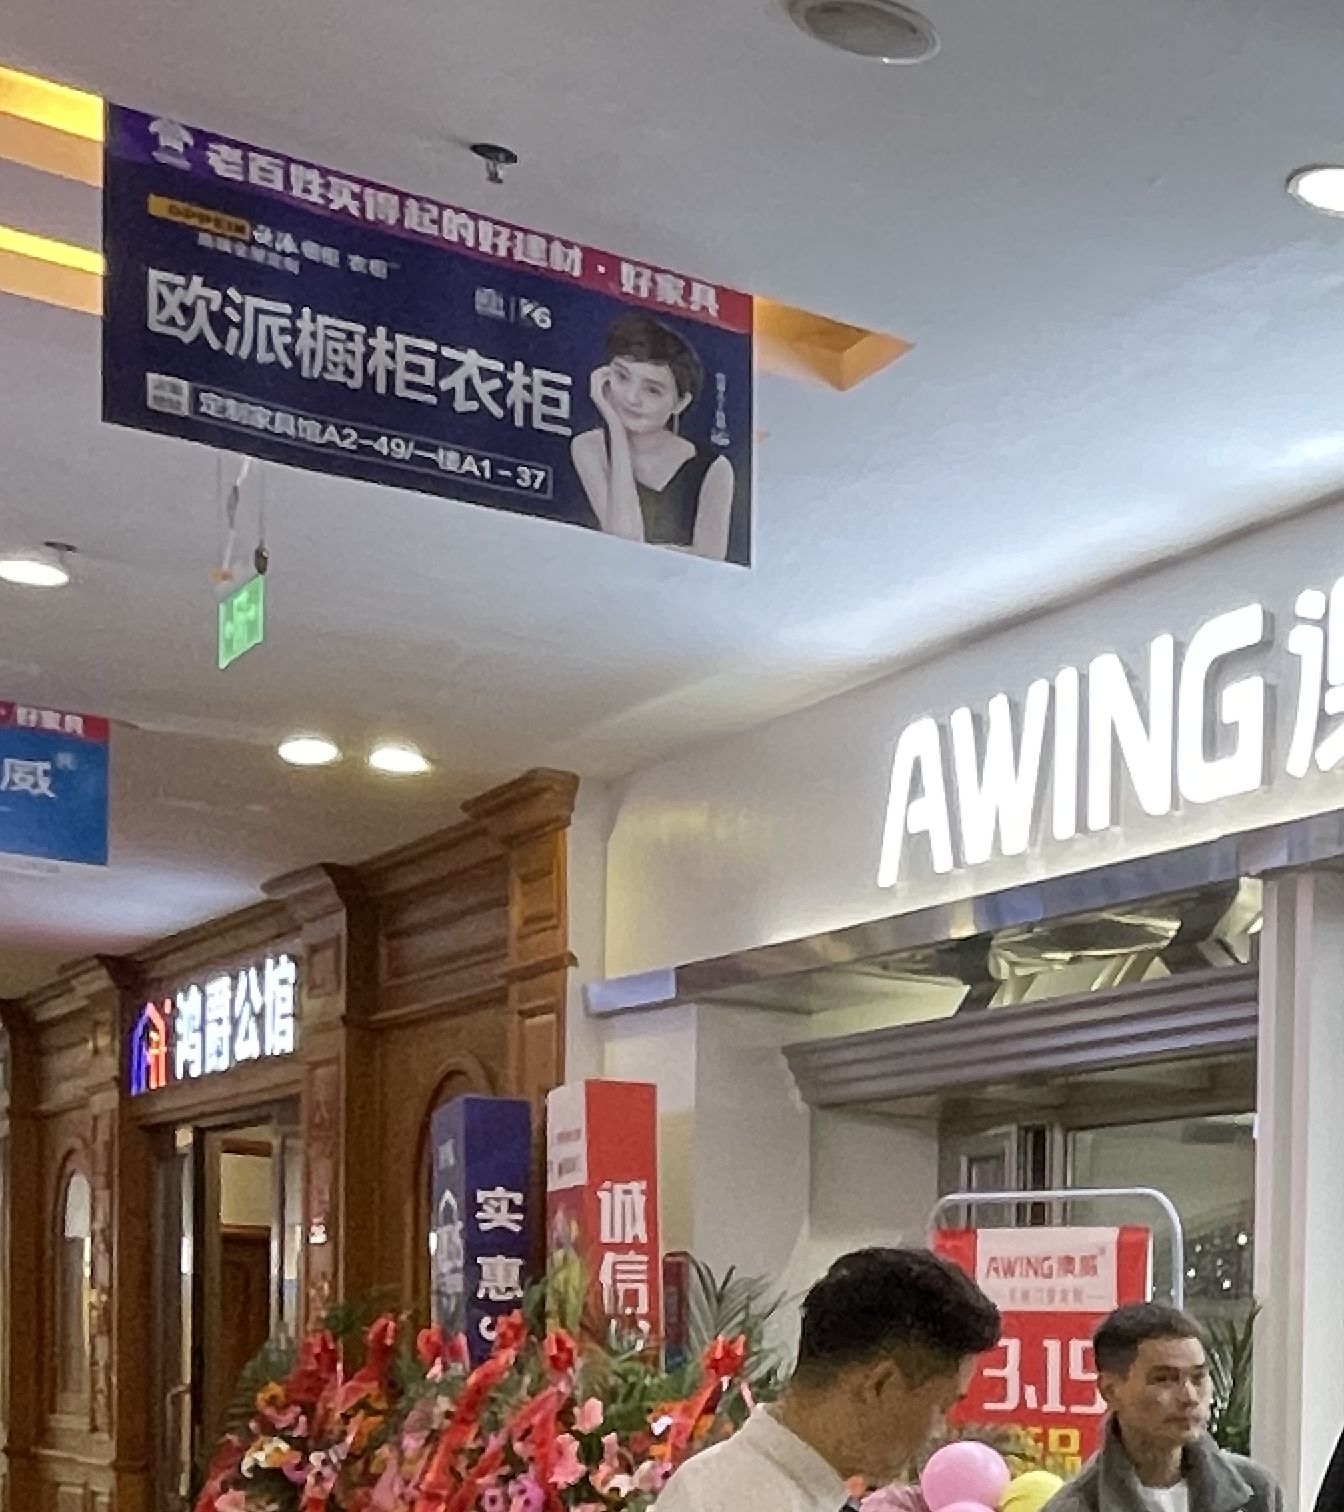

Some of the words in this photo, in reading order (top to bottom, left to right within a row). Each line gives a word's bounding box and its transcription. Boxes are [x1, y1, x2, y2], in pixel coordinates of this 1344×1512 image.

[146, 267, 574, 437] 欧派橱柜衣柜
[597, 1180, 651, 1350] 诚信
[982, 1338, 1108, 1414] 3.15
